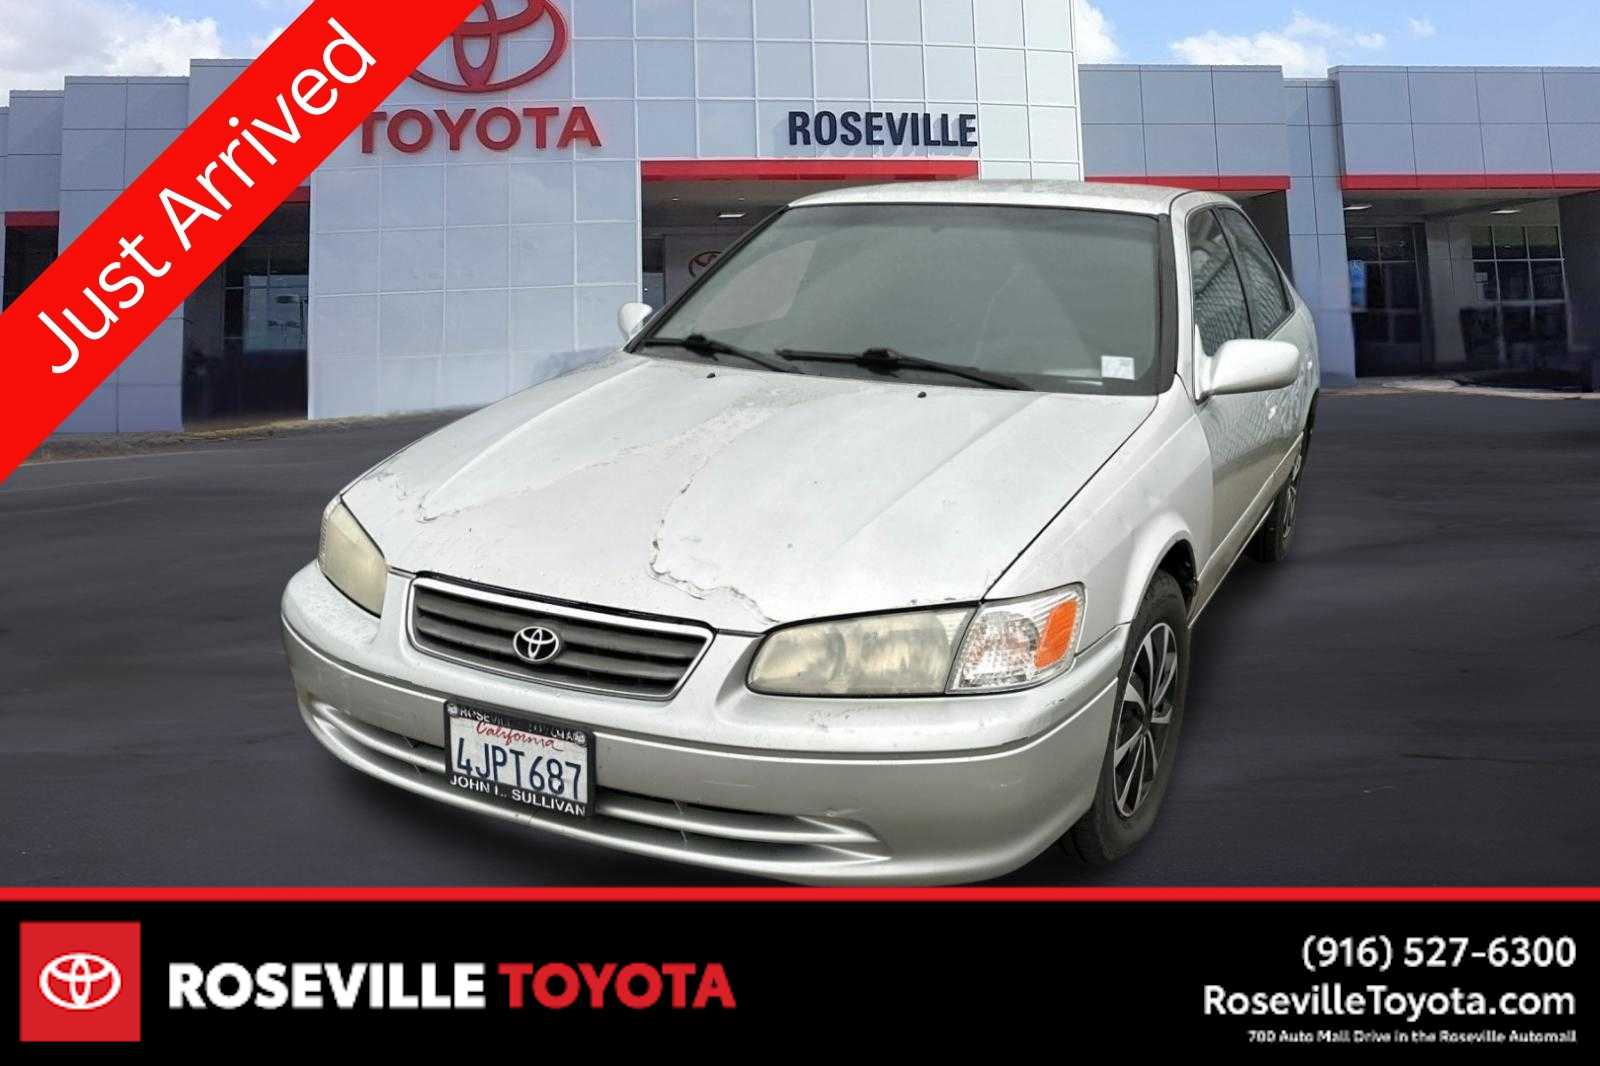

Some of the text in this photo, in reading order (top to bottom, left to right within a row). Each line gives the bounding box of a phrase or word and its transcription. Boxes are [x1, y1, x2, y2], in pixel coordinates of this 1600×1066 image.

[361, 106, 601, 154] TOYOTA
[788, 110, 978, 147] ROSEVILLE
[476, 721, 564, 751] California
[456, 737, 582, 800] 4JPT687
[450, 774, 491, 794] JOHN
[511, 788, 586, 817] SULLIVAN
